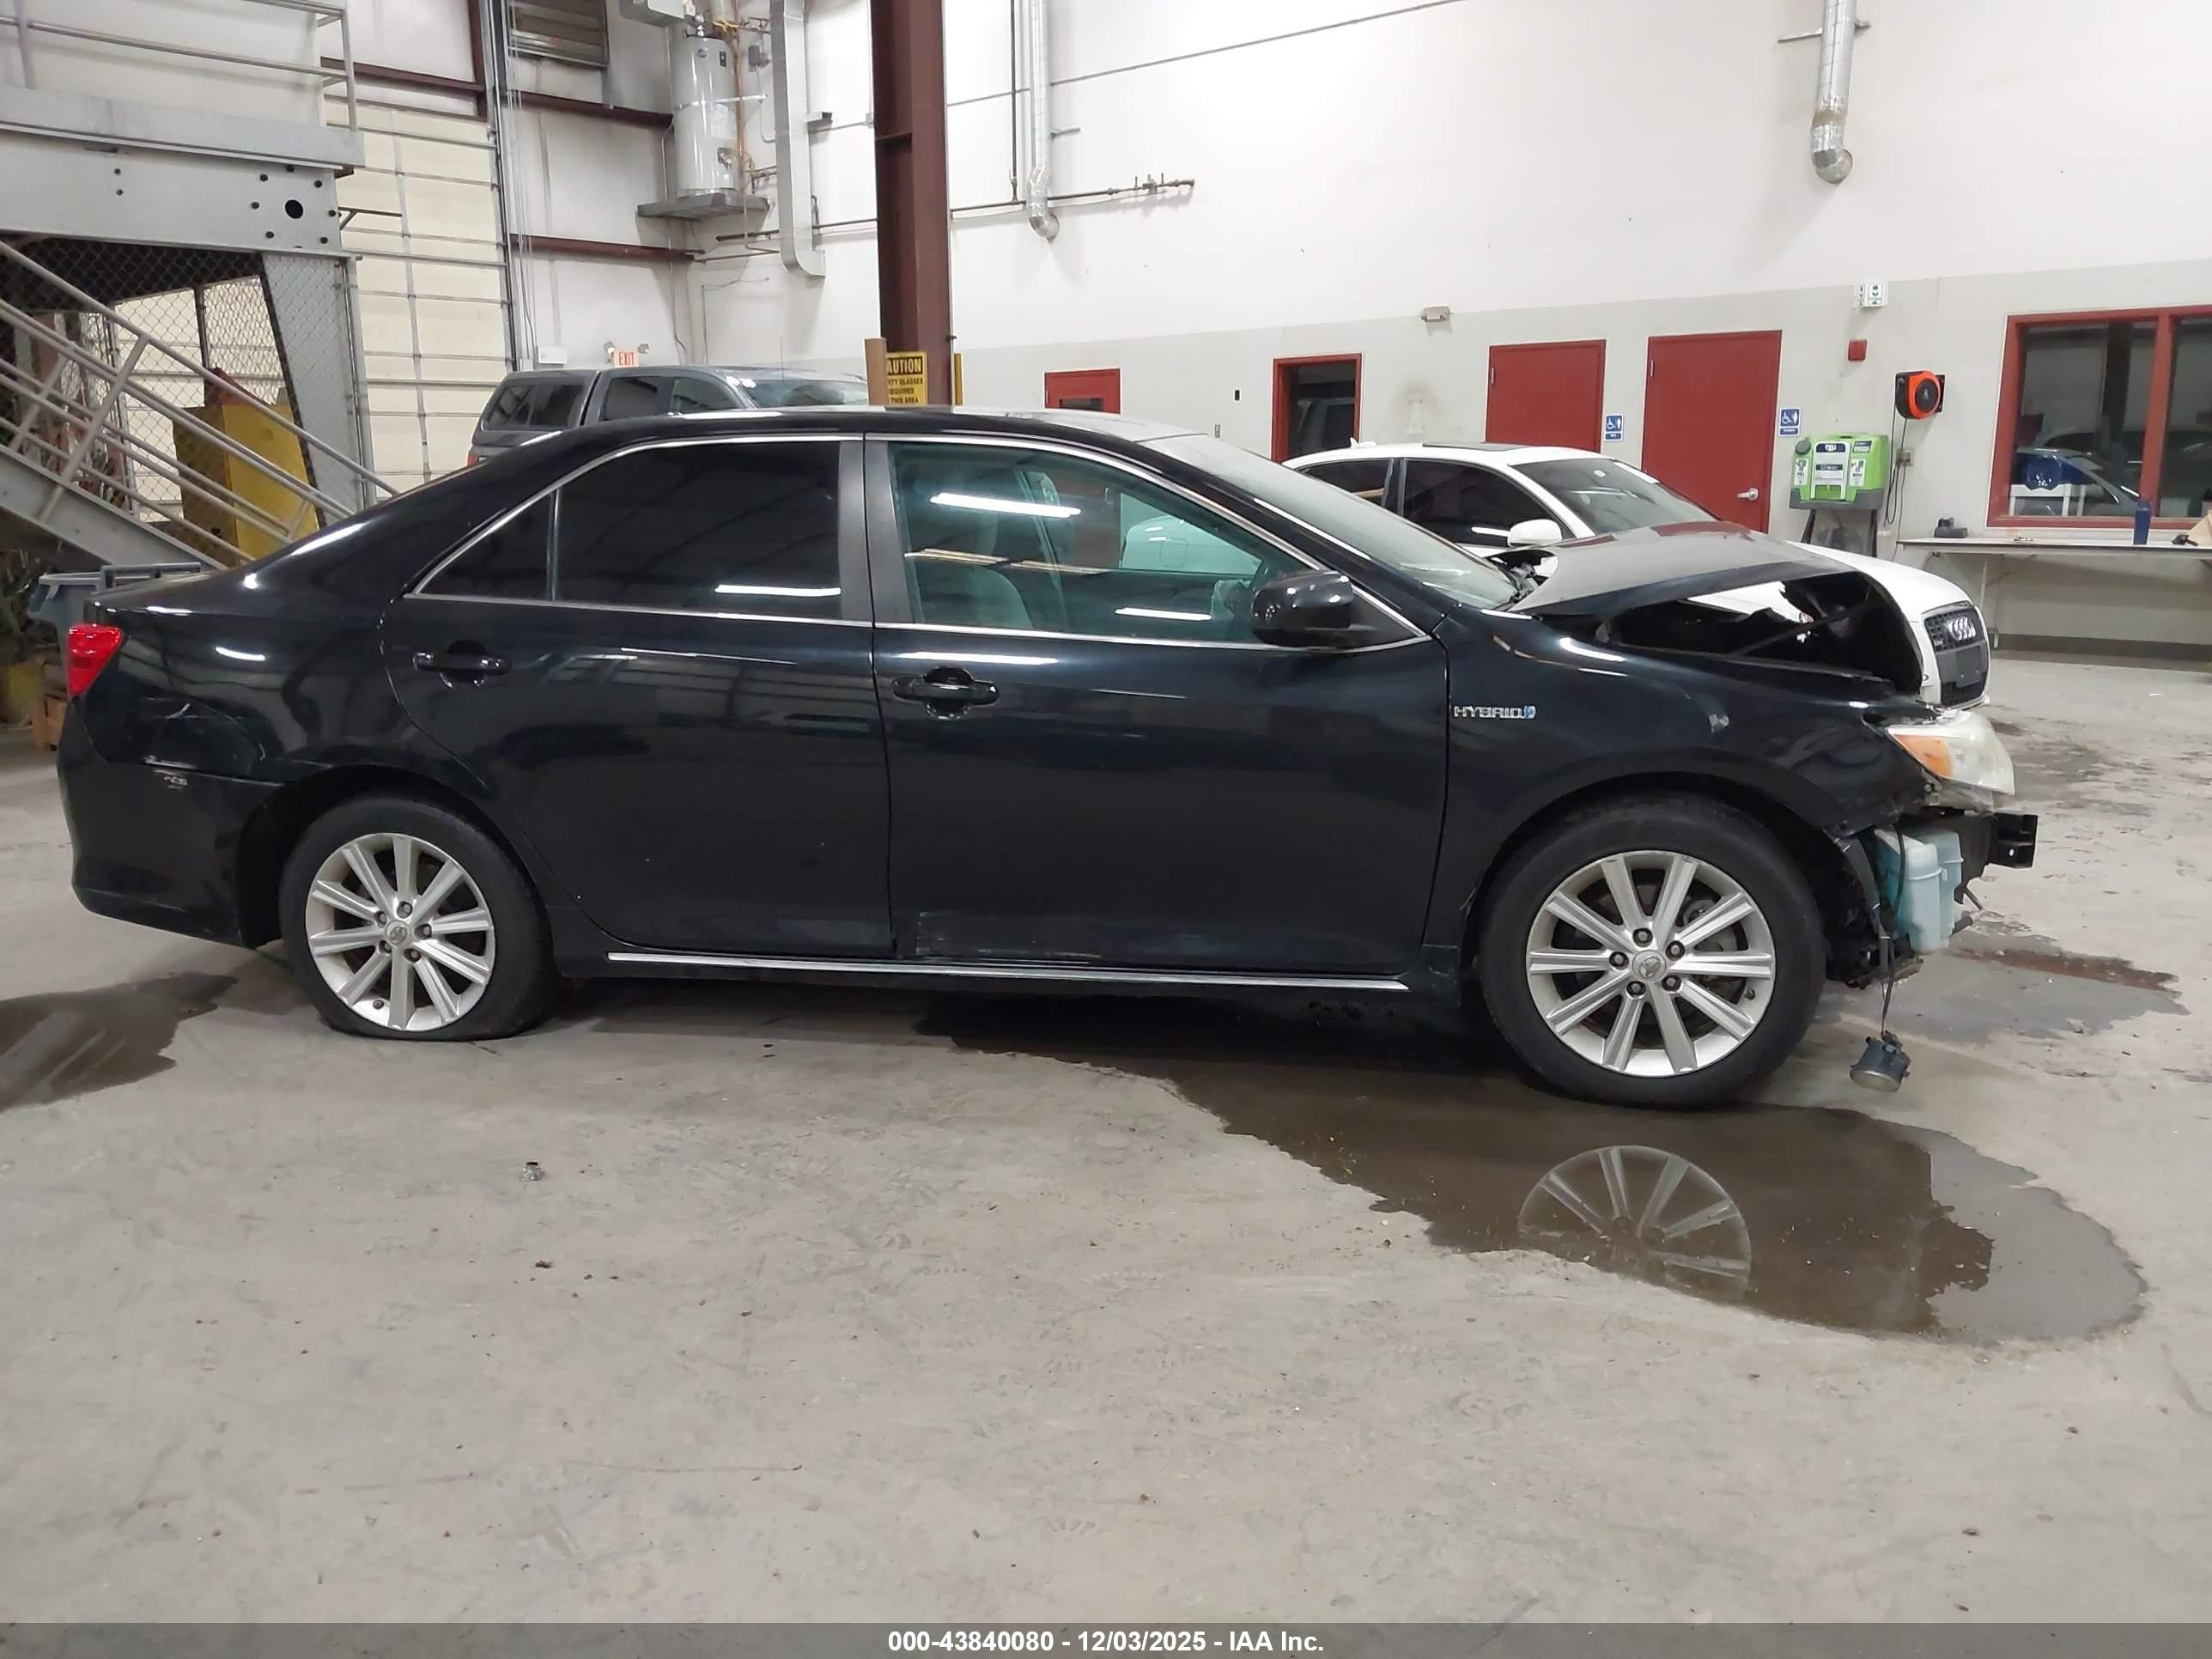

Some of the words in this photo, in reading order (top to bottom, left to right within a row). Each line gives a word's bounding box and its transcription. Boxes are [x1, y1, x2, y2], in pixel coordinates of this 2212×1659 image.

[618, 350, 635, 367] EXIT
[886, 357, 921, 374] AUTION
[1454, 705, 1522, 720] HYBRID
